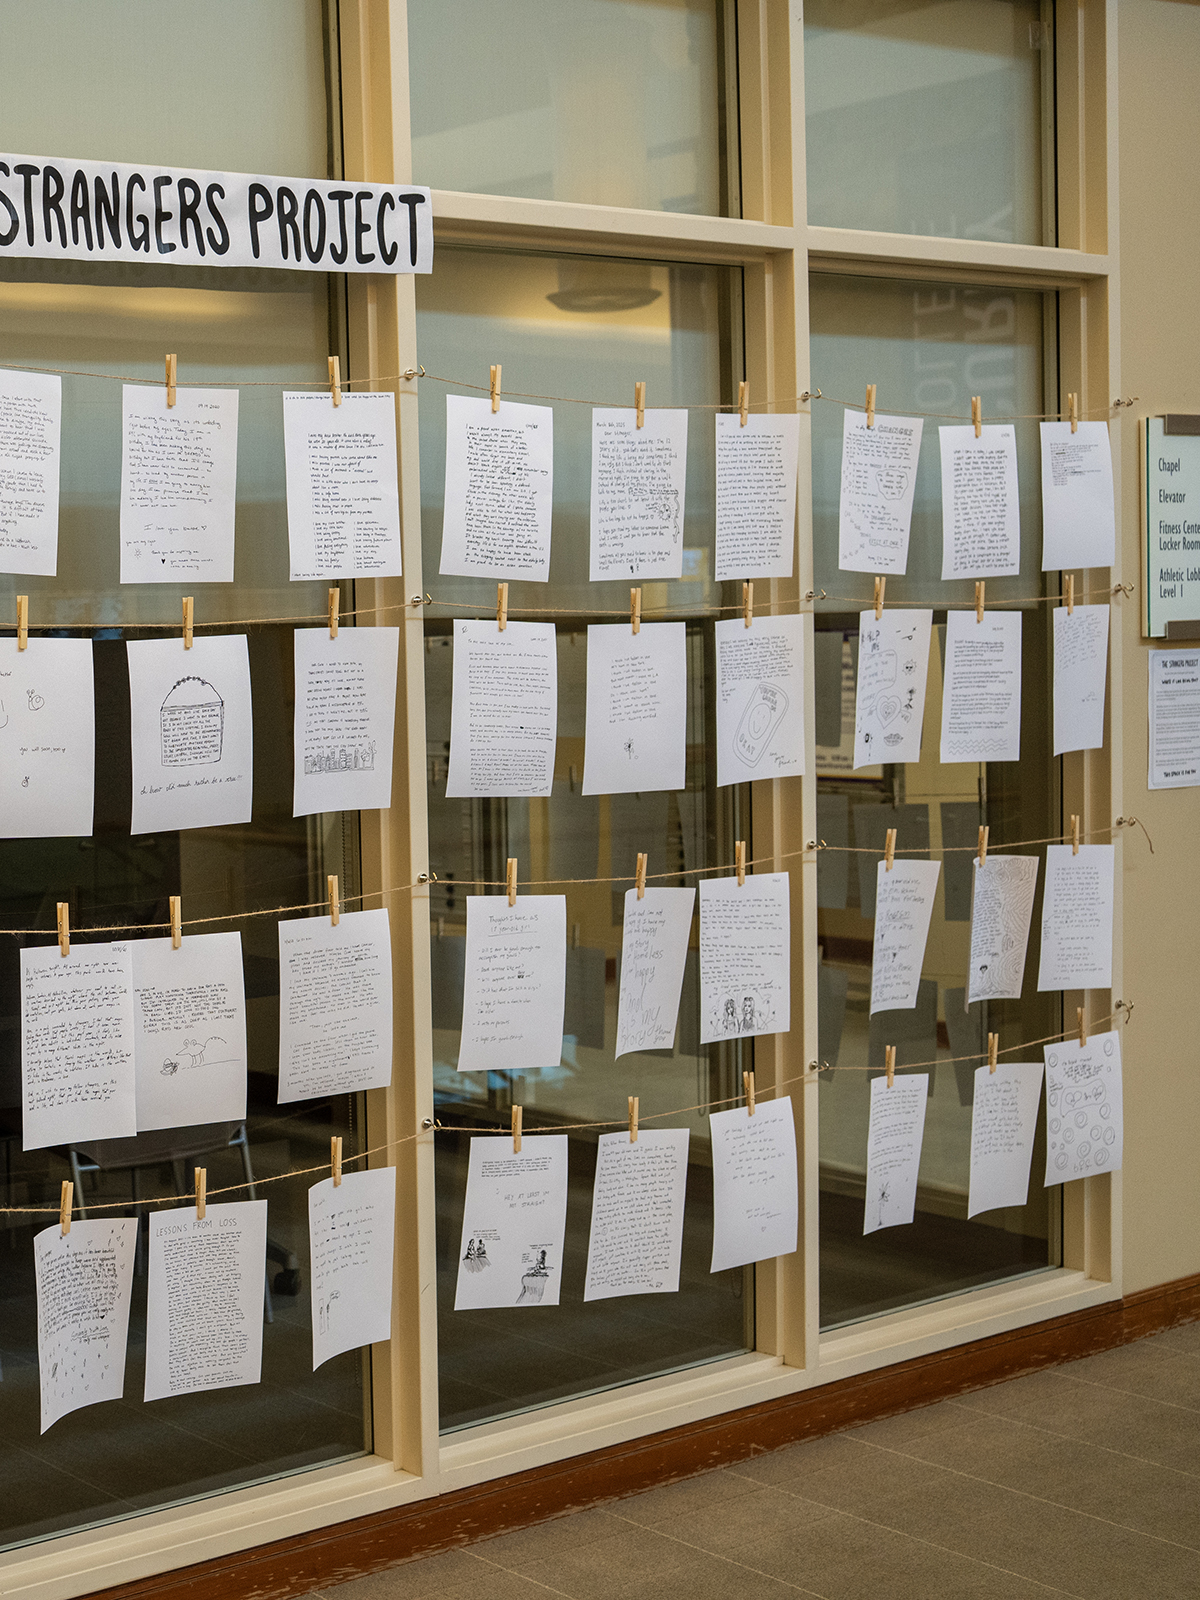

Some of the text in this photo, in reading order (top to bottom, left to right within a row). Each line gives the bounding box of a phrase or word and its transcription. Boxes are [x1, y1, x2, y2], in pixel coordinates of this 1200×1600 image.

[247, 182, 426, 267] PROJECT
[1159, 458, 1180, 476] Chapel
[1159, 489, 1186, 503] Elevator
[1159, 520, 1181, 534] Fitness
[1159, 537, 1181, 550] Locker
[1160, 568, 1184, 581] Athletic
[1160, 584, 1176, 598] Level
[156, 1218, 237, 1237] LESSONS FROM LOSS
